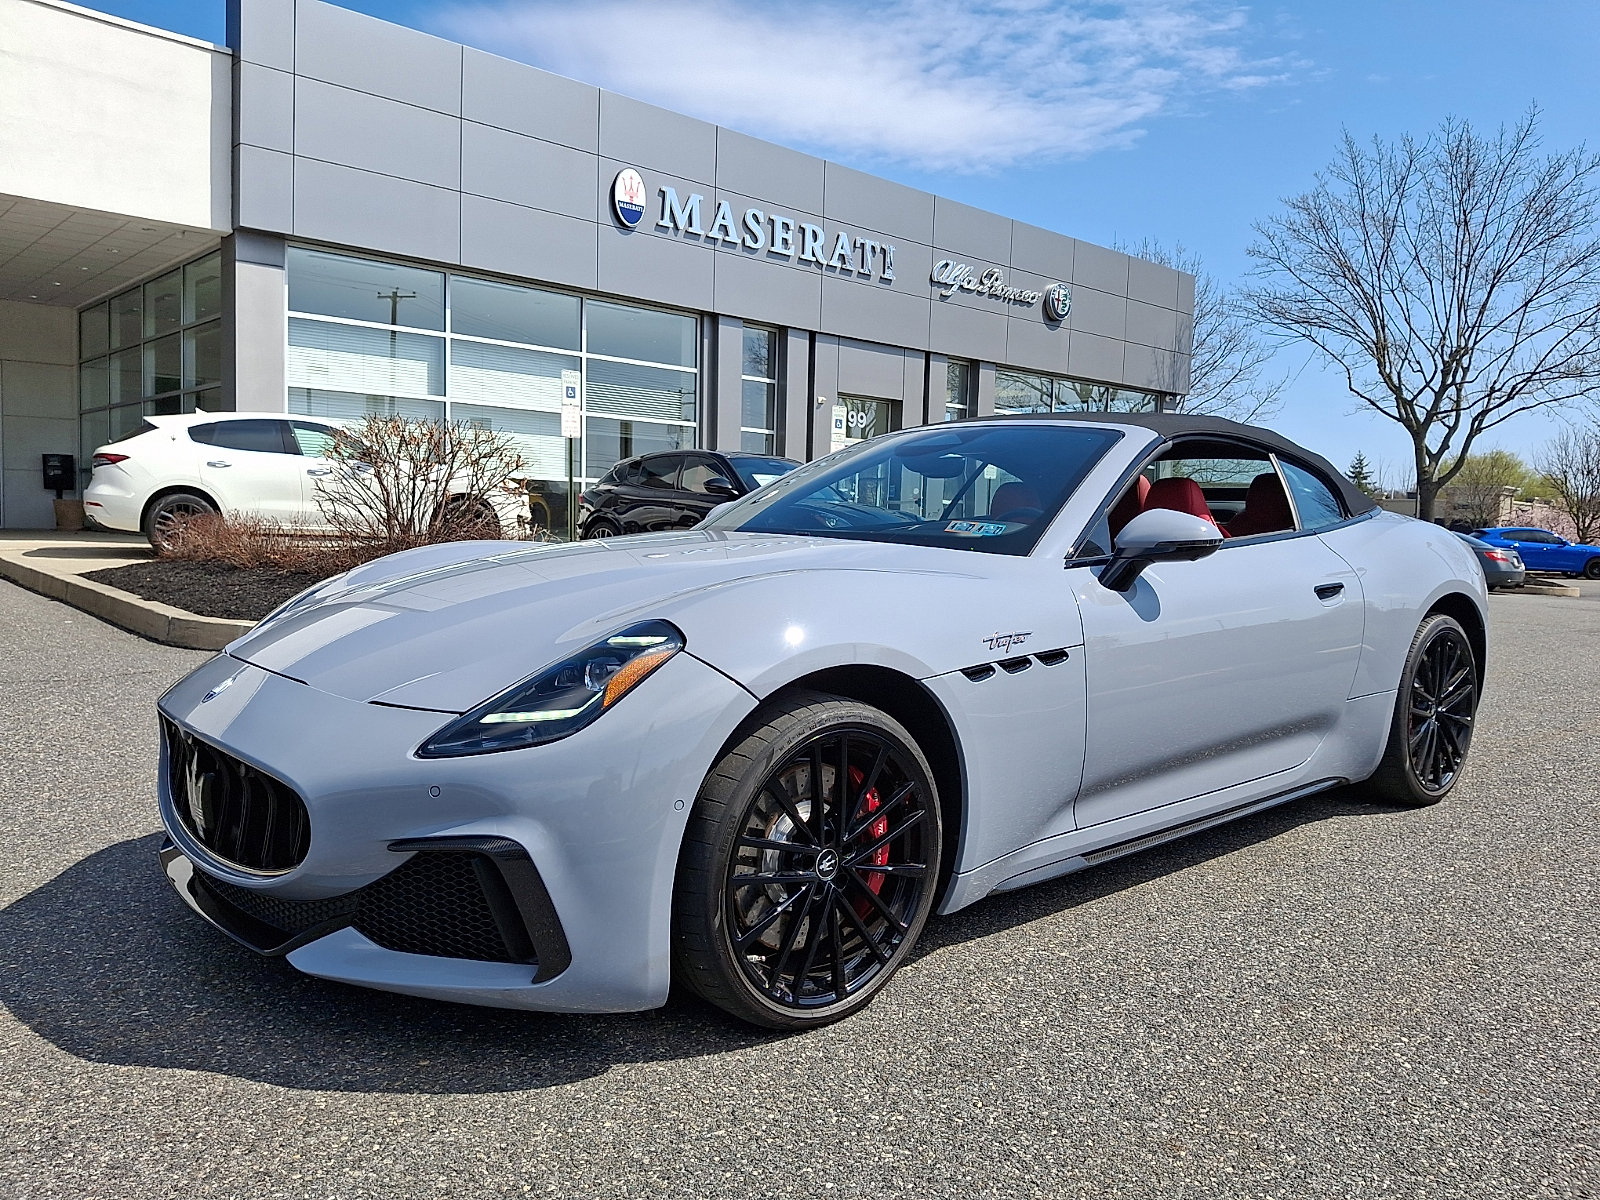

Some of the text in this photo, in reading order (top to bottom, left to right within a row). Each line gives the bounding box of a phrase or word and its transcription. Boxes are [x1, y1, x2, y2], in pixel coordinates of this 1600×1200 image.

[657, 186, 896, 280] MASERATI
[931, 260, 977, 296] Alfa
[978, 267, 1042, 304] Romeo
[848, 411, 866, 428] 99
